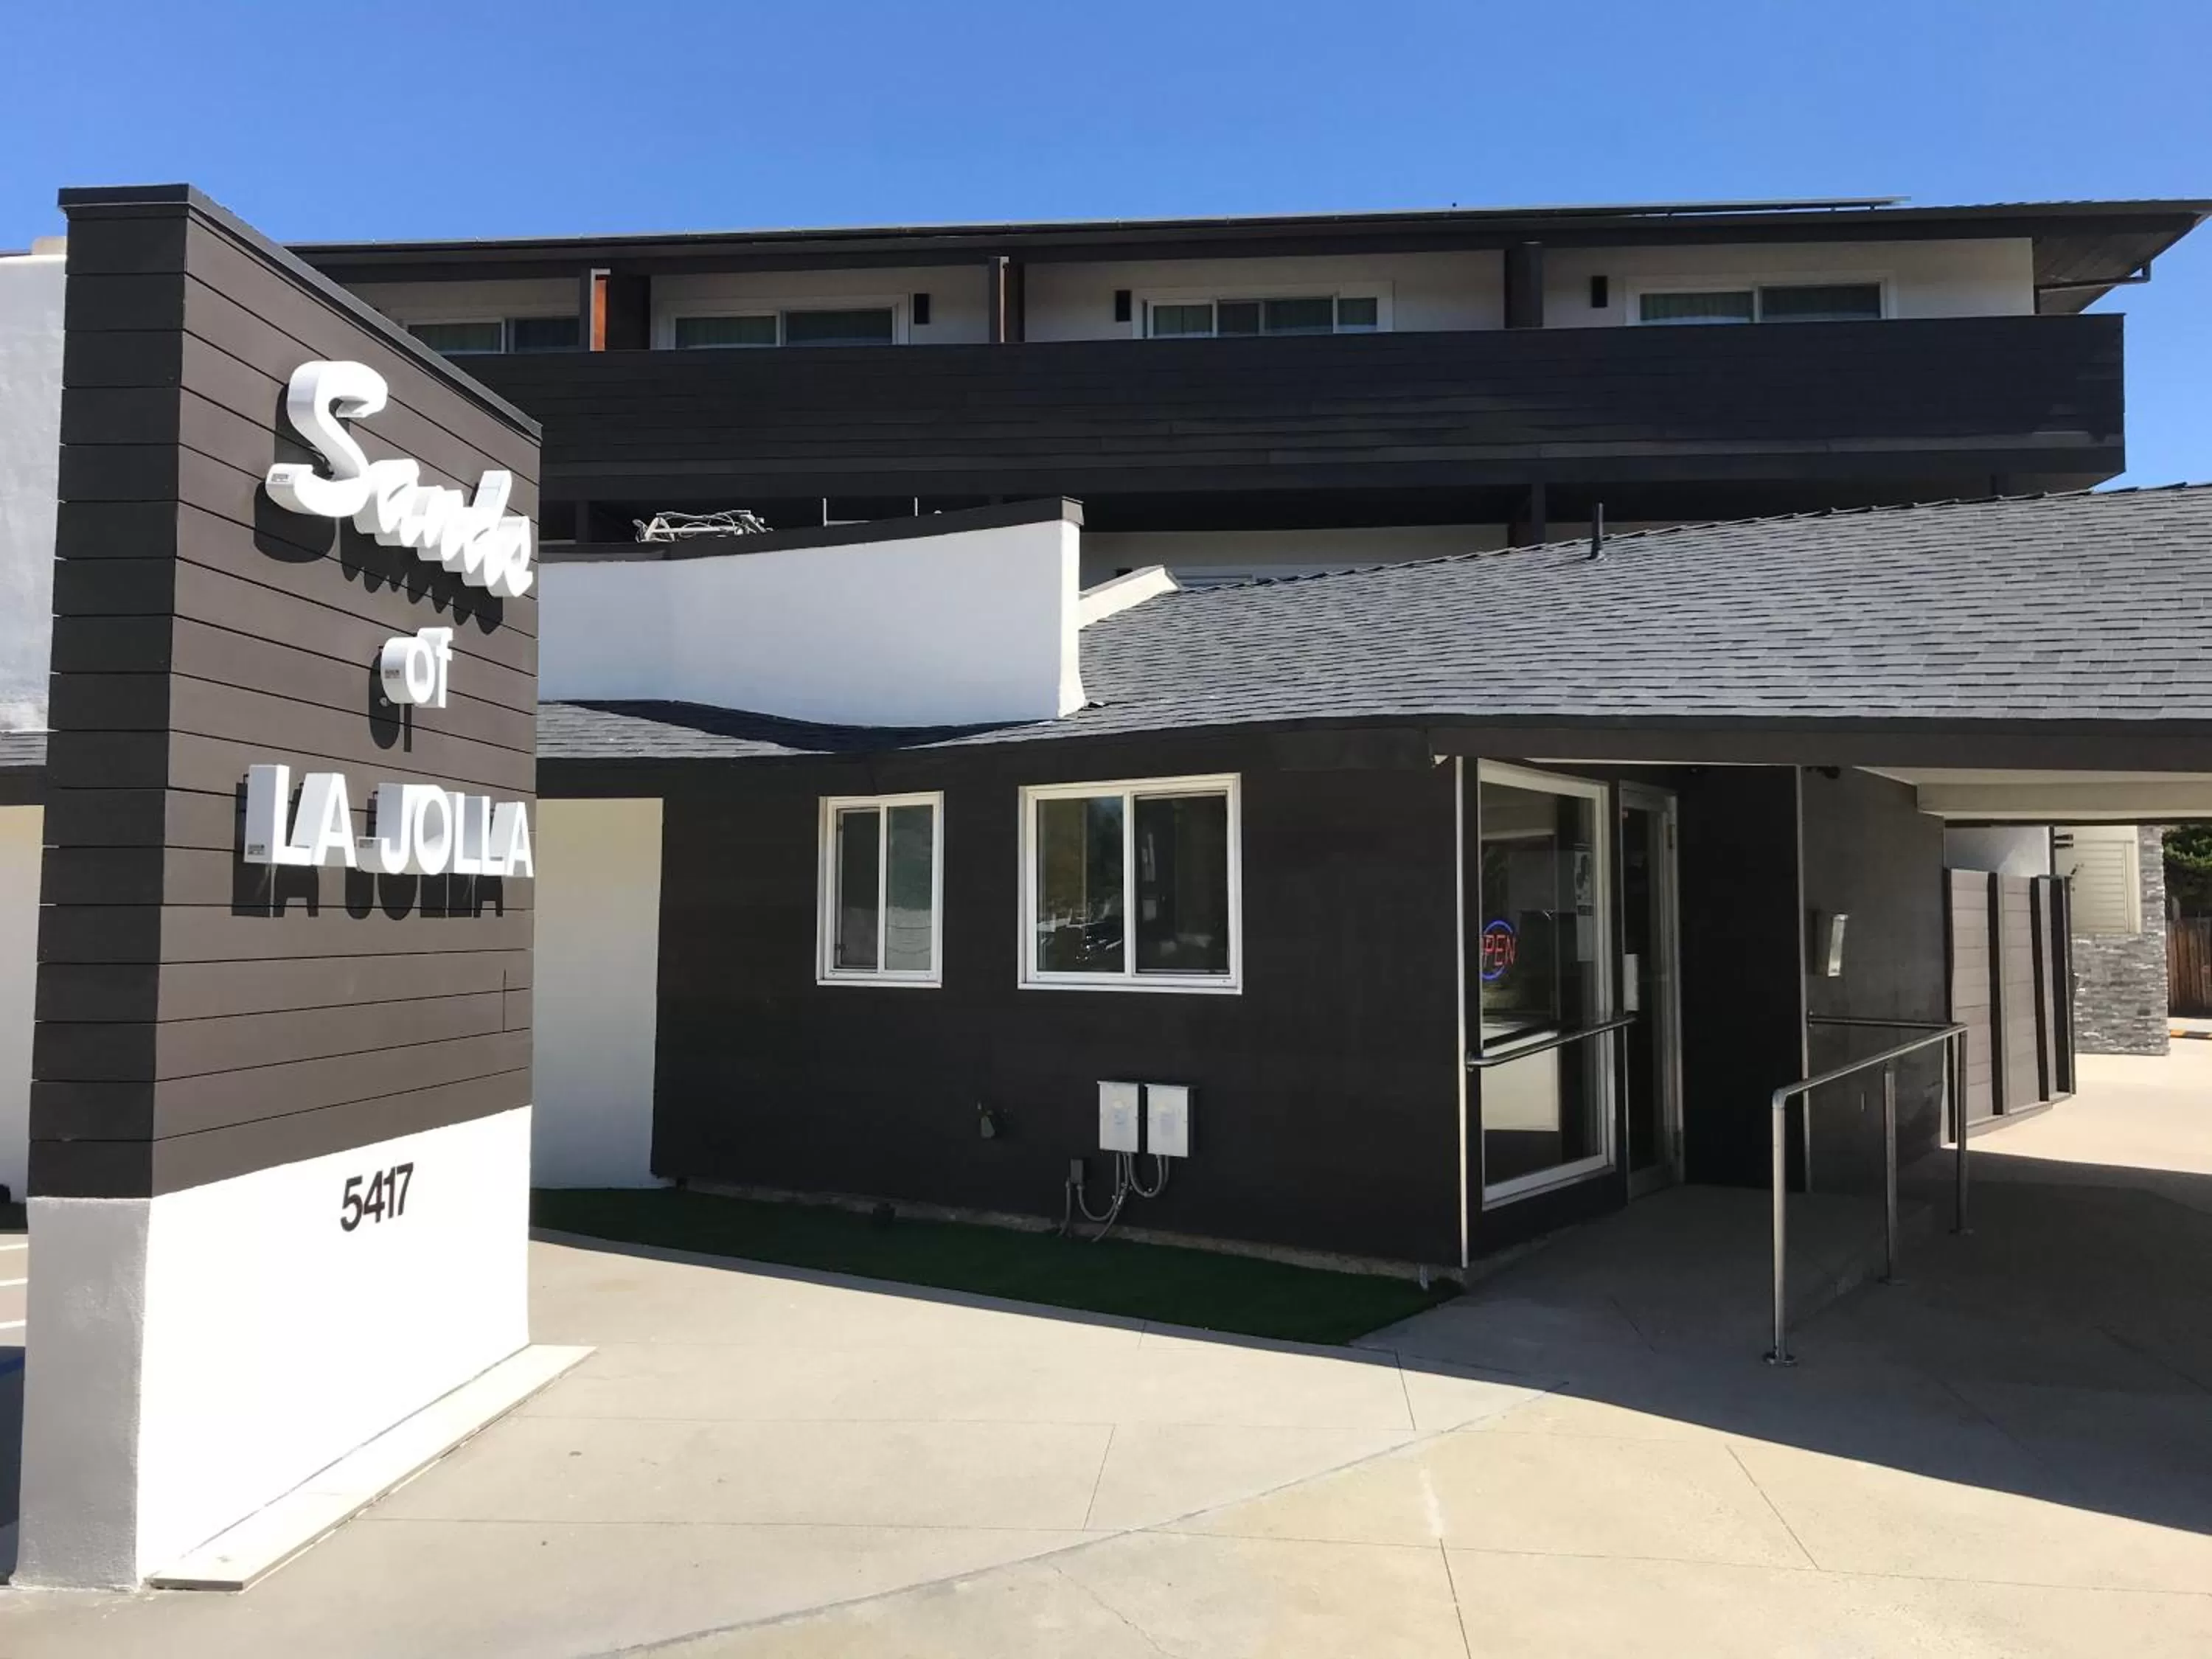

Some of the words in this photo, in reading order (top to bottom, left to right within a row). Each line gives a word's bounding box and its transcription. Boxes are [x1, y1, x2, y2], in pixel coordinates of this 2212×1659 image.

[265, 361, 533, 597] Sands
[244, 764, 358, 868] LA
[358, 783, 534, 877] JOLLA
[1481, 933, 1516, 967] PEN
[341, 1161, 414, 1232] 5417
